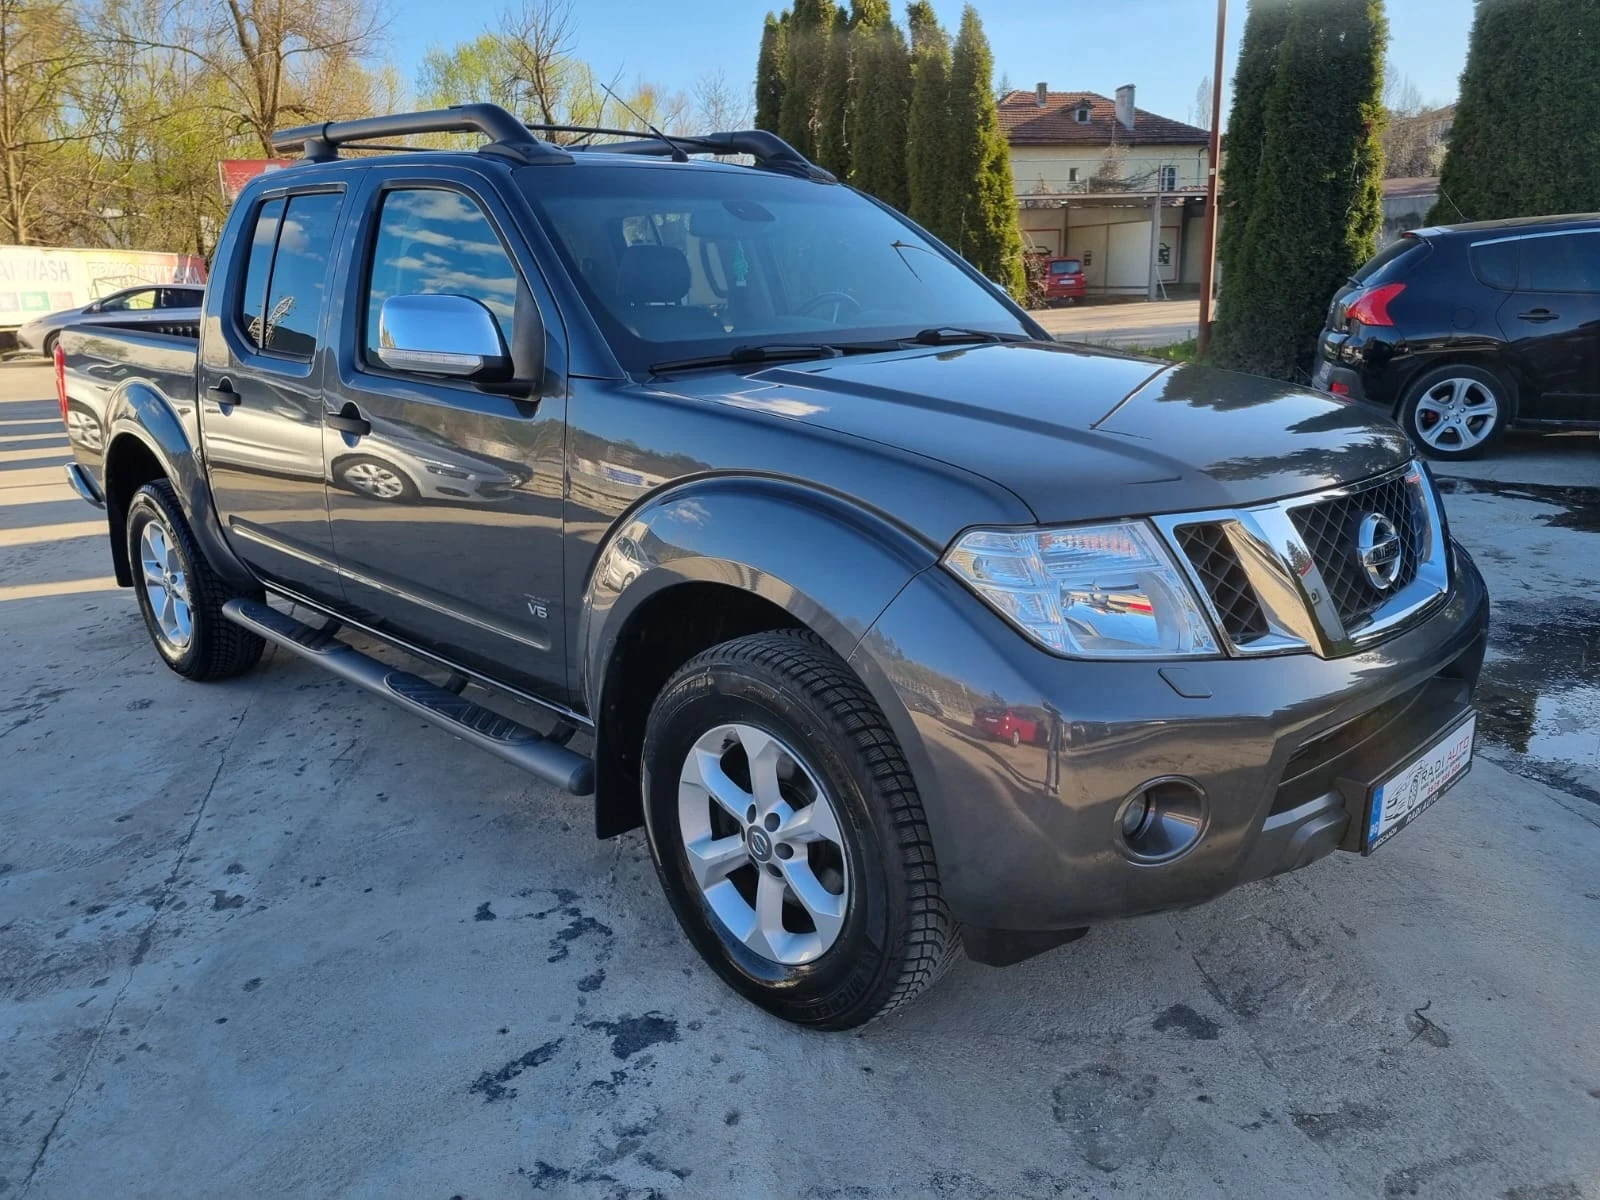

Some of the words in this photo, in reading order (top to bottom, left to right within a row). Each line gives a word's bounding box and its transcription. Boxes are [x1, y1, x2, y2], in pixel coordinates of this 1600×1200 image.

[527, 602, 548, 619] V6
[1420, 754, 1445, 784] RADI
[1447, 735, 1470, 763] AUTO
[1369, 821, 1380, 838] BG
